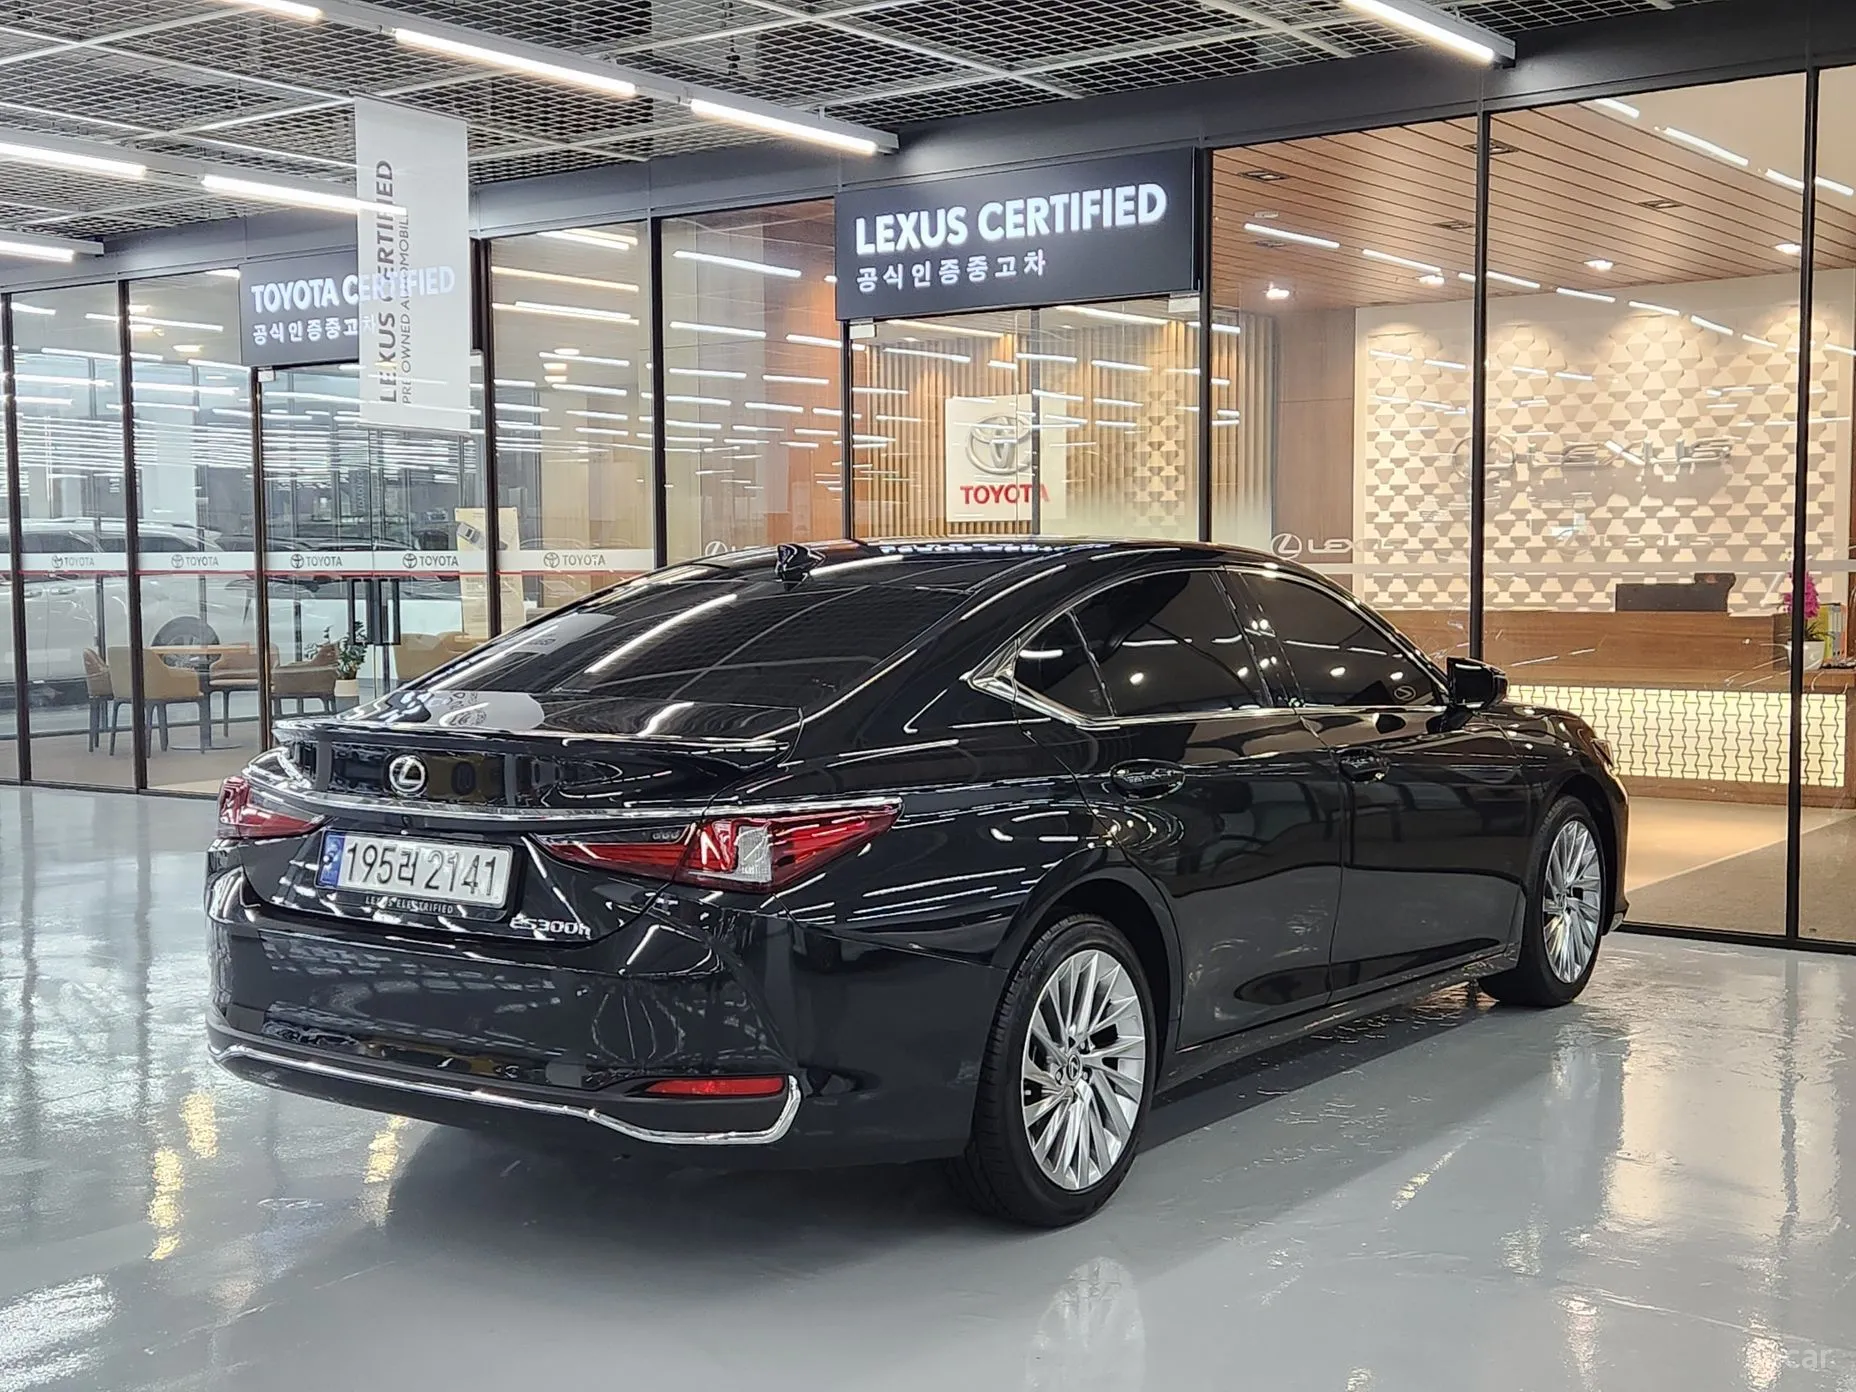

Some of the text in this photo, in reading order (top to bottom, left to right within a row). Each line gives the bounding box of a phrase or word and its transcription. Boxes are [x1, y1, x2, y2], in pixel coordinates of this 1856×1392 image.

[855, 183, 1168, 256] LEXUS CERTIFIED
[398, 212, 411, 311] AOMOBIL
[251, 265, 455, 314] TOYOTA CERTIFIED
[378, 311, 397, 403] LEXUS
[399, 313, 412, 373] OWNED
[64, 556, 95, 567] TOYOTA
[185, 556, 219, 567] TOYOTA
[306, 556, 343, 567] TOYOTA
[419, 555, 459, 567] TOYOTA
[562, 554, 606, 566] TOYOTA
[423, 849, 497, 897] 2141
[365, 895, 454, 914] LES ELETRIFIED
